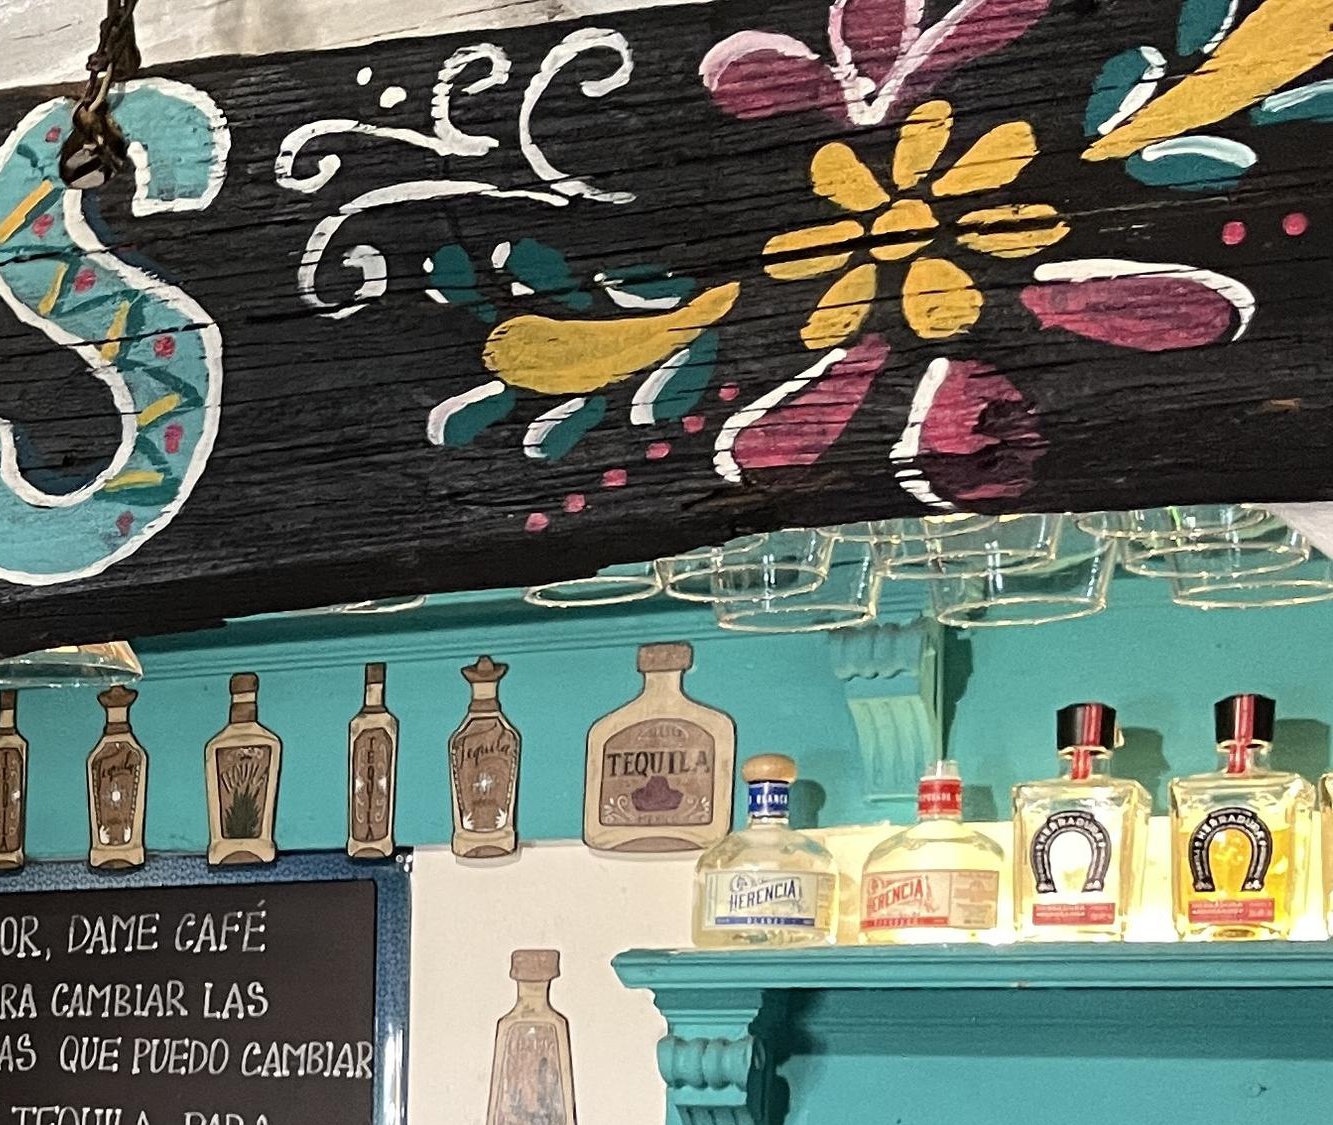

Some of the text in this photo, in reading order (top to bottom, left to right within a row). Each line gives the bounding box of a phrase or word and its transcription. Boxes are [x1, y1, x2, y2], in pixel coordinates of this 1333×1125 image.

[459, 722, 511, 770] Tequila
[607, 750, 711, 777] TEQUILA
[366, 735, 376, 841] TEQUILA
[1196, 813, 1268, 842] HERRADURA
[729, 879, 796, 912] HERENCIA
[67, 912, 160, 955] DAME
[174, 900, 267, 954] CAFÉ
[51, 980, 189, 1018] CAMBIAR
[203, 981, 269, 1019] LAS
[59, 1035, 122, 1074] QUE
[132, 1037, 229, 1075] PUEDO
[241, 1041, 373, 1079] CAMBIAR
